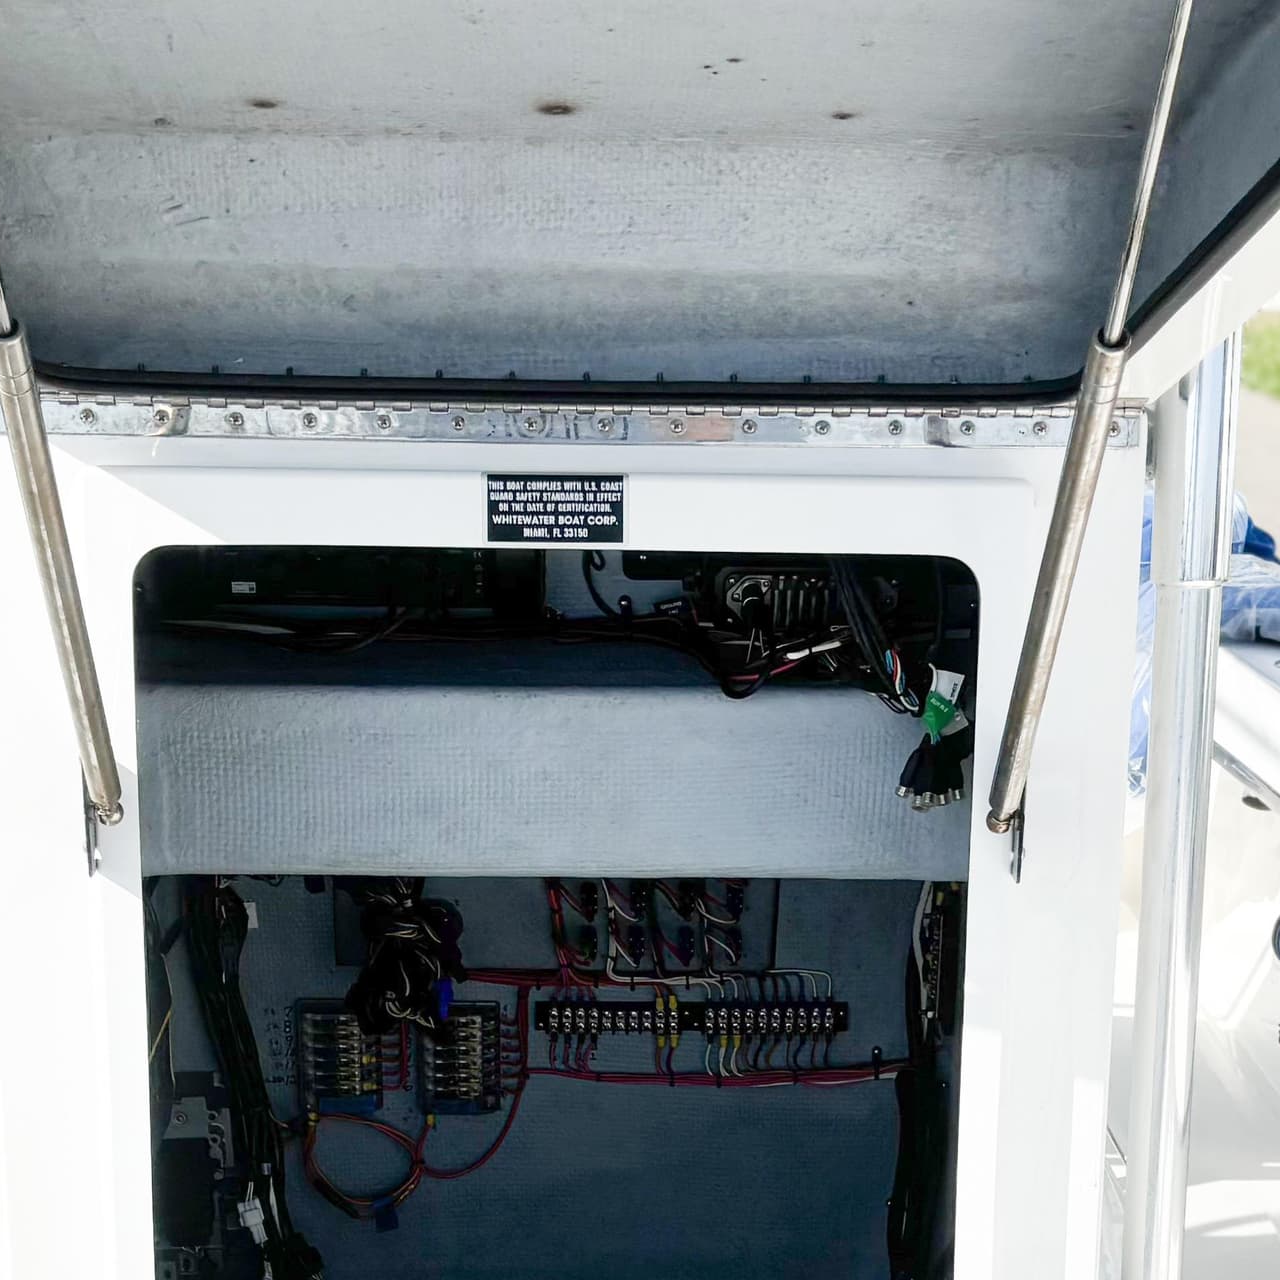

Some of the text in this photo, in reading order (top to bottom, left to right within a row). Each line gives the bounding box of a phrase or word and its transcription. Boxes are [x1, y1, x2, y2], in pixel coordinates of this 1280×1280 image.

[488, 481, 623, 490] THIS BOAT COMPLIES WITH U.S. COAST
[490, 491, 621, 502] GUARD SAFETY STANDARDS IN EFFECT
[498, 502, 509, 513] ON
[511, 502, 524, 513] THE
[526, 502, 544, 513] DATE
[546, 502, 555, 513] OF
[492, 514, 619, 526] WHITEWATER BOAT CORP.
[523, 527, 589, 538] MIAMI, FL 33150
